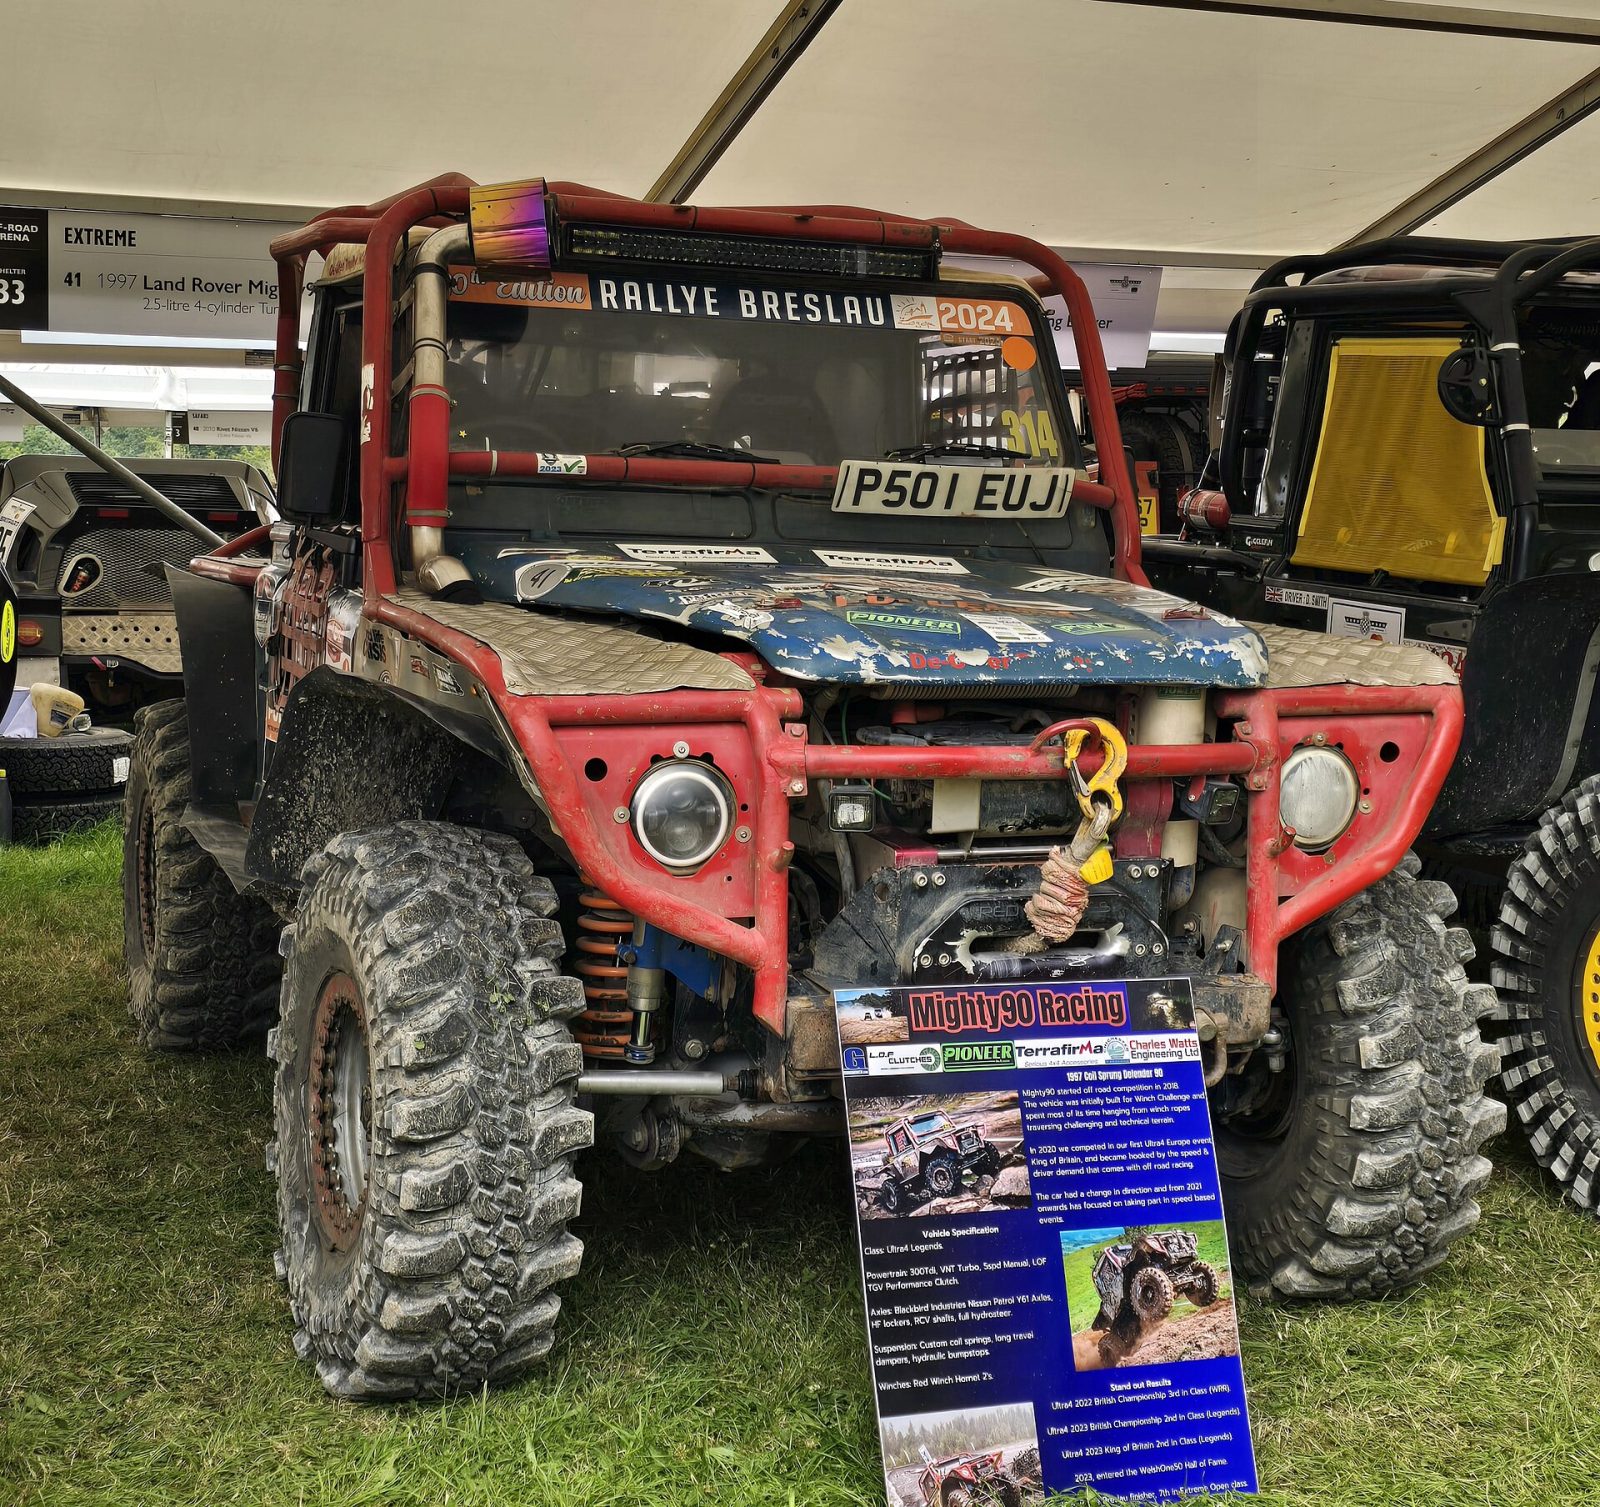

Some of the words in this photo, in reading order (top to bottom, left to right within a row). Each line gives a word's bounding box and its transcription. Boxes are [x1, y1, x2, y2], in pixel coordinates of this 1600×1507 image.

[64, 227, 137, 247] EXTREME
[64, 272, 82, 288] 41
[97, 272, 138, 290] 1997
[143, 275, 185, 292] Land
[192, 277, 243, 294] Rover
[143, 297, 190, 312] 2.5-litre
[194, 299, 255, 316] 4-cylinder
[600, 279, 720, 316] RALLYE
[738, 289, 885, 326] BRESLAU
[939, 303, 1014, 332] 2024
[175, 429, 180, 437] 3
[1001, 409, 1058, 457] 314
[852, 468, 960, 510] P501
[974, 473, 1059, 512] EUJ
[530, 568, 556, 589] 41
[850, 612, 954, 631] PIONEER
[979, 905, 1019, 918] RED
[909, 989, 1036, 1034] Mighty90
[1036, 986, 1127, 1027] Racing
[943, 1044, 1012, 1062] PIONEER
[1016, 1040, 1106, 1058] TerrafirMa
[1129, 1038, 1168, 1050] Charles
[1168, 1037, 1198, 1049] Watts
[888, 1056, 932, 1065] CLUTCHES
[1024, 1060, 1048, 1068] Serious
[1061, 1058, 1099, 1067] Accessories
[1130, 1048, 1183, 1061] Engineering
[1184, 1048, 1200, 1058] Ltd
[1066, 1071, 1082, 1081] 1997
[1083, 1071, 1097, 1081] Coil
[1097, 1070, 1122, 1081] Sprung
[1153, 1068, 1163, 1077] 90
[1056, 1086, 1082, 1095] started
[1083, 1085, 1093, 1094] off
[1094, 1085, 1111, 1093] road
[1112, 1083, 1153, 1093] competition
[1023, 1100, 1037, 1108] The
[1038, 1099, 1063, 1107] vehicle
[1080, 1096, 1104, 1106] initially
[1105, 1096, 1121, 1104] built
[1122, 1095, 1133, 1103] for
[1133, 1094, 1156, 1102] Winch
[1156, 1093, 1190, 1102] Challenge
[1191, 1091, 1205, 1099] and
[1025, 1112, 1045, 1121] spent
[1065, 1109, 1073, 1117] of
[1074, 1109, 1084, 1117] its
[1101, 1107, 1130, 1116] hanging
[1149, 1104, 1169, 1112] winch
[1170, 1105, 1190, 1113] ropes
[1026, 1122, 1062, 1131] traversing
[1063, 1120, 1103, 1129] challenging
[1104, 1118, 1118, 1127] and
[1119, 1117, 1149, 1126] technical
[921, 1228, 950, 1238] Vehicle
[951, 1225, 999, 1237] Specification
[939, 1264, 955, 1273] VNT
[983, 1260, 1001, 1271] 5spd
[1032, 1257, 1046, 1266] LOF
[893, 1303, 929, 1314] Blackbird
[930, 1301, 966, 1311] Industries
[967, 1299, 992, 1308] Nissan
[993, 1296, 1014, 1305] Patrol
[1016, 1294, 1029, 1303] Y61
[871, 1320, 881, 1328] HF
[913, 1315, 930, 1325] RCV
[958, 1311, 969, 1321] full
[919, 1340, 948, 1349] Custom
[949, 1337, 963, 1346] coil
[994, 1333, 1011, 1343] long
[1012, 1330, 1034, 1340] travel
[911, 1351, 946, 1364] hydraulic
[912, 1377, 928, 1387] Red
[929, 1375, 954, 1385] Winch
[1109, 1381, 1131, 1391] Stand
[1132, 1381, 1145, 1389] out
[1145, 1378, 1171, 1387] Results
[1074, 1398, 1092, 1407] 2022
[1093, 1395, 1116, 1406] British
[1117, 1391, 1166, 1403] Championship
[1167, 1389, 1180, 1398] 3rd
[1189, 1387, 1207, 1395] Class
[1096, 1469, 1124, 1480] entered
[1125, 1468, 1138, 1476] the
[1184, 1460, 1197, 1469] Hall
[1198, 1458, 1206, 1467] of
